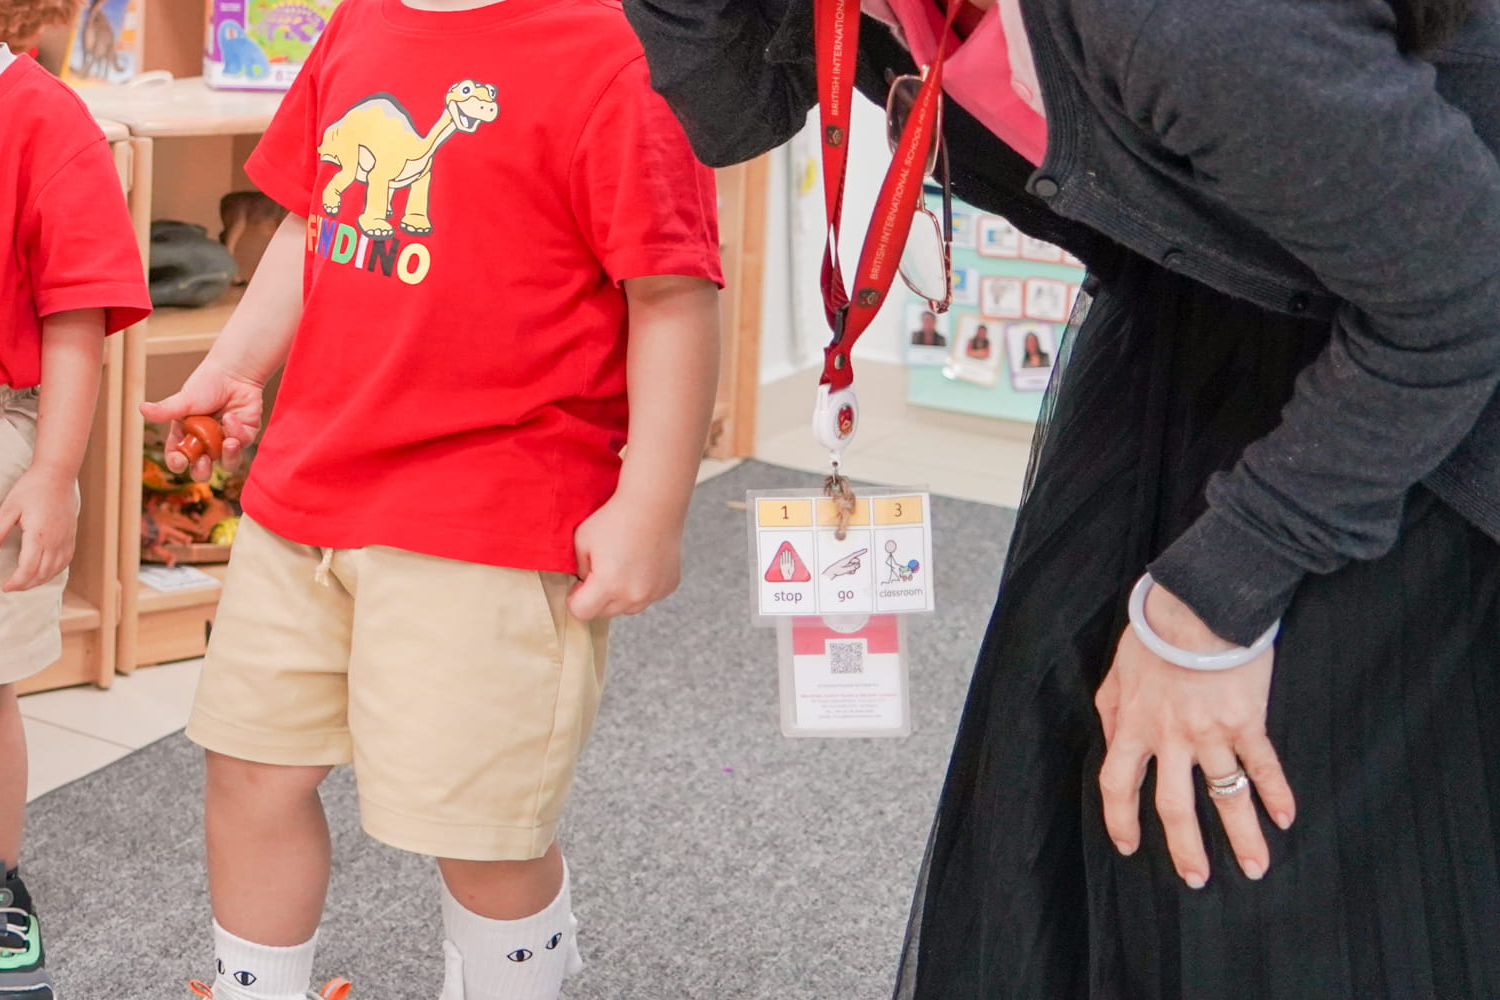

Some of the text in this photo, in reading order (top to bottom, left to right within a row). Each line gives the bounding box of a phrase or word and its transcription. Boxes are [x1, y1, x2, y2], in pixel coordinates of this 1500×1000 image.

[831, 75, 839, 116] BRITISH
[870, 244, 886, 280] BRITISH
[880, 168, 910, 244] INTERNATIONAL
[905, 127, 923, 166] SCHOOL
[780, 502, 903, 519] 1 3
[774, 587, 923, 604] stop go classroom
